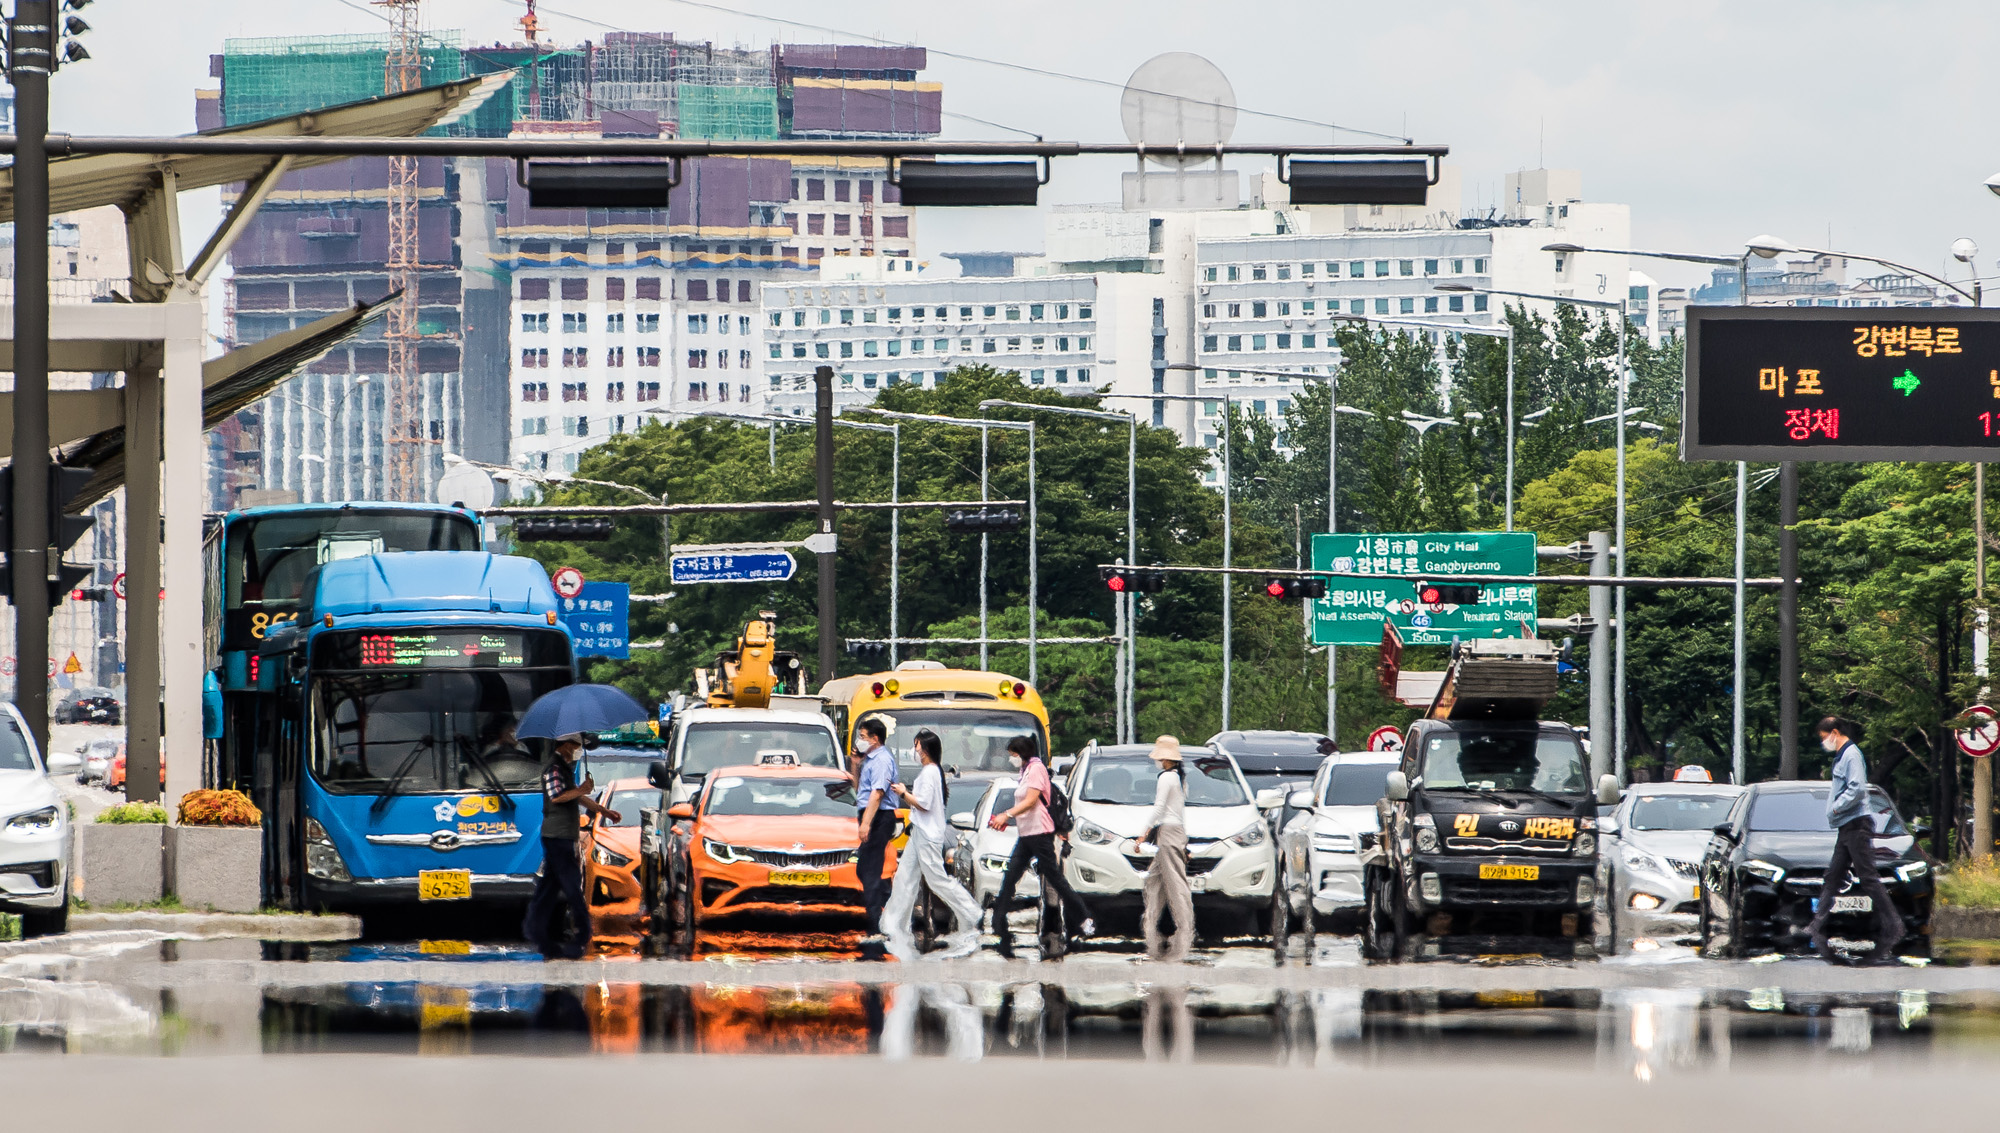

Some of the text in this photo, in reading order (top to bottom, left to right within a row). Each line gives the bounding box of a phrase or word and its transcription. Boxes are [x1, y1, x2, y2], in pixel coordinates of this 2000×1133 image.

[1853, 325, 1963, 357] 강변북로
[1784, 408, 1840, 440] 정체
[1425, 542, 1450, 553] City
[1455, 541, 1479, 552] Hall
[1357, 557, 1420, 574] 강변북로
[1425, 560, 1501, 573] Gangbyeonno
[1318, 589, 1387, 608] 국회의사당
[1477, 586, 1533, 606] 의나루역
[1340, 610, 1385, 621] Assembly
[1414, 617, 1429, 627] 46
[1504, 609, 1534, 621] Station
[1411, 631, 1441, 643] 150m
[1453, 813, 1480, 837] 민
